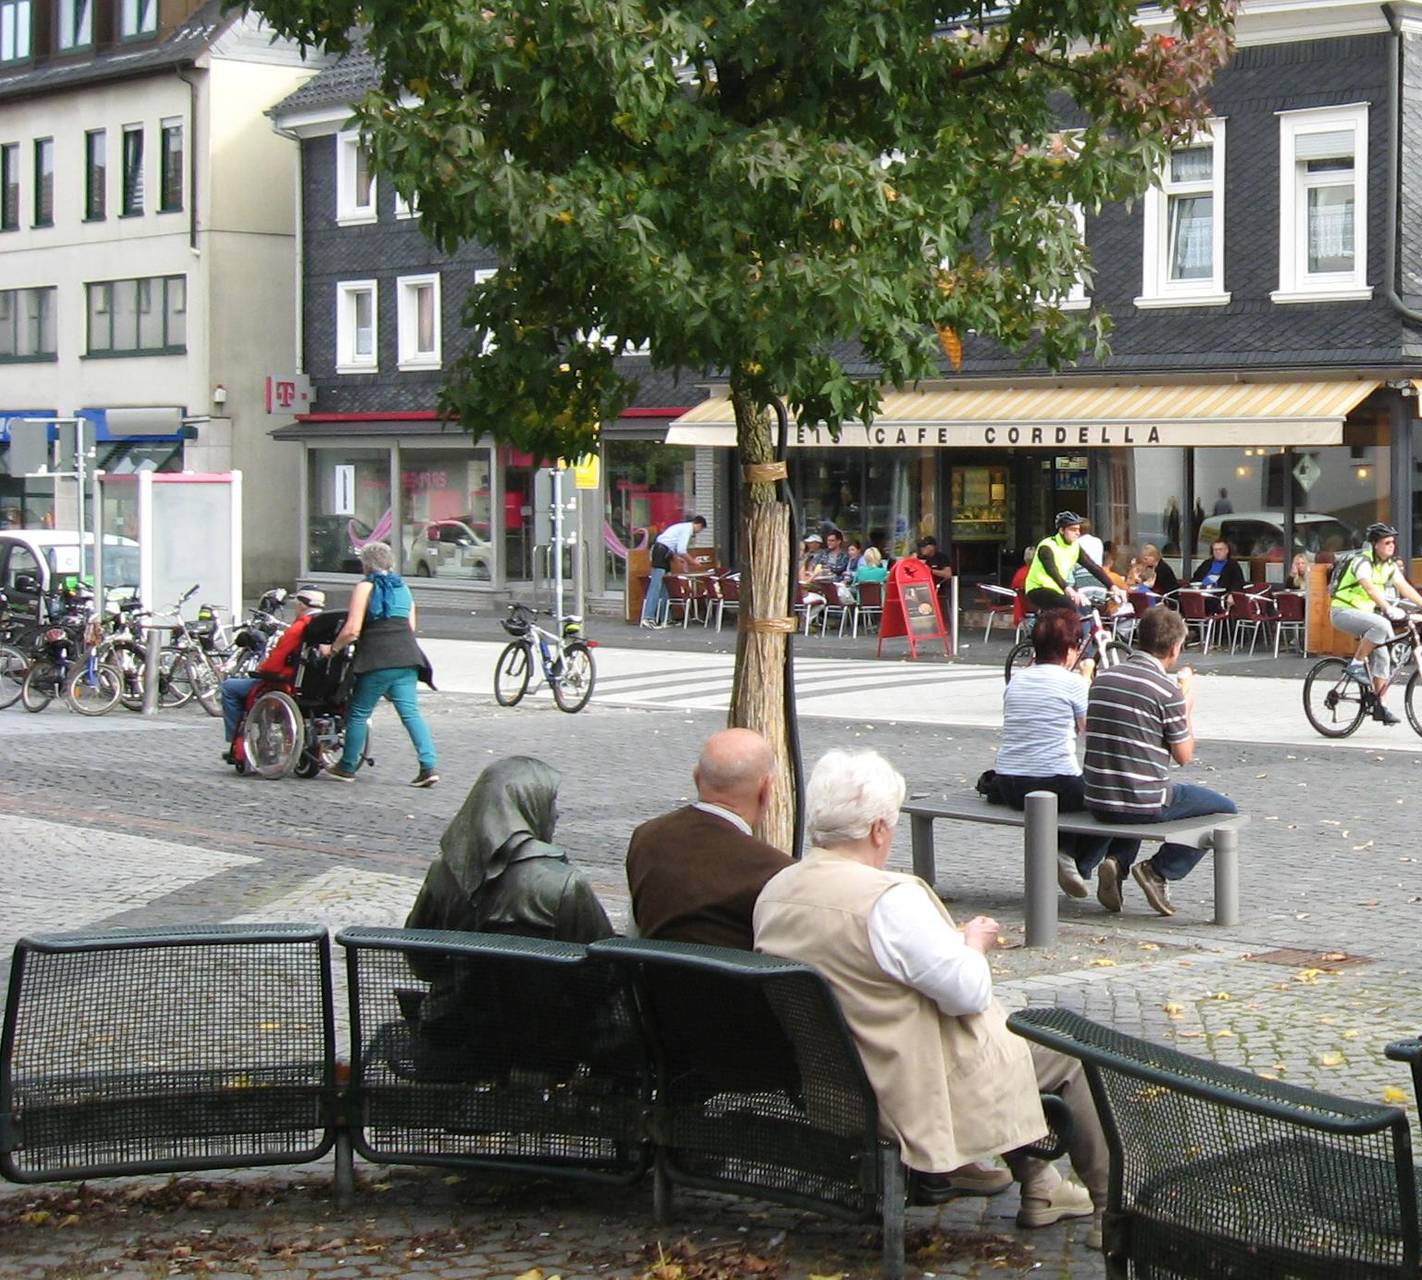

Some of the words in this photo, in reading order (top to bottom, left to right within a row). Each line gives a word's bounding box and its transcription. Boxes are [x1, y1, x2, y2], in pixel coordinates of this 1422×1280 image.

[276, 382, 295, 407] T
[875, 428, 948, 444] CAFE
[984, 426, 1160, 444] CORDELLA
